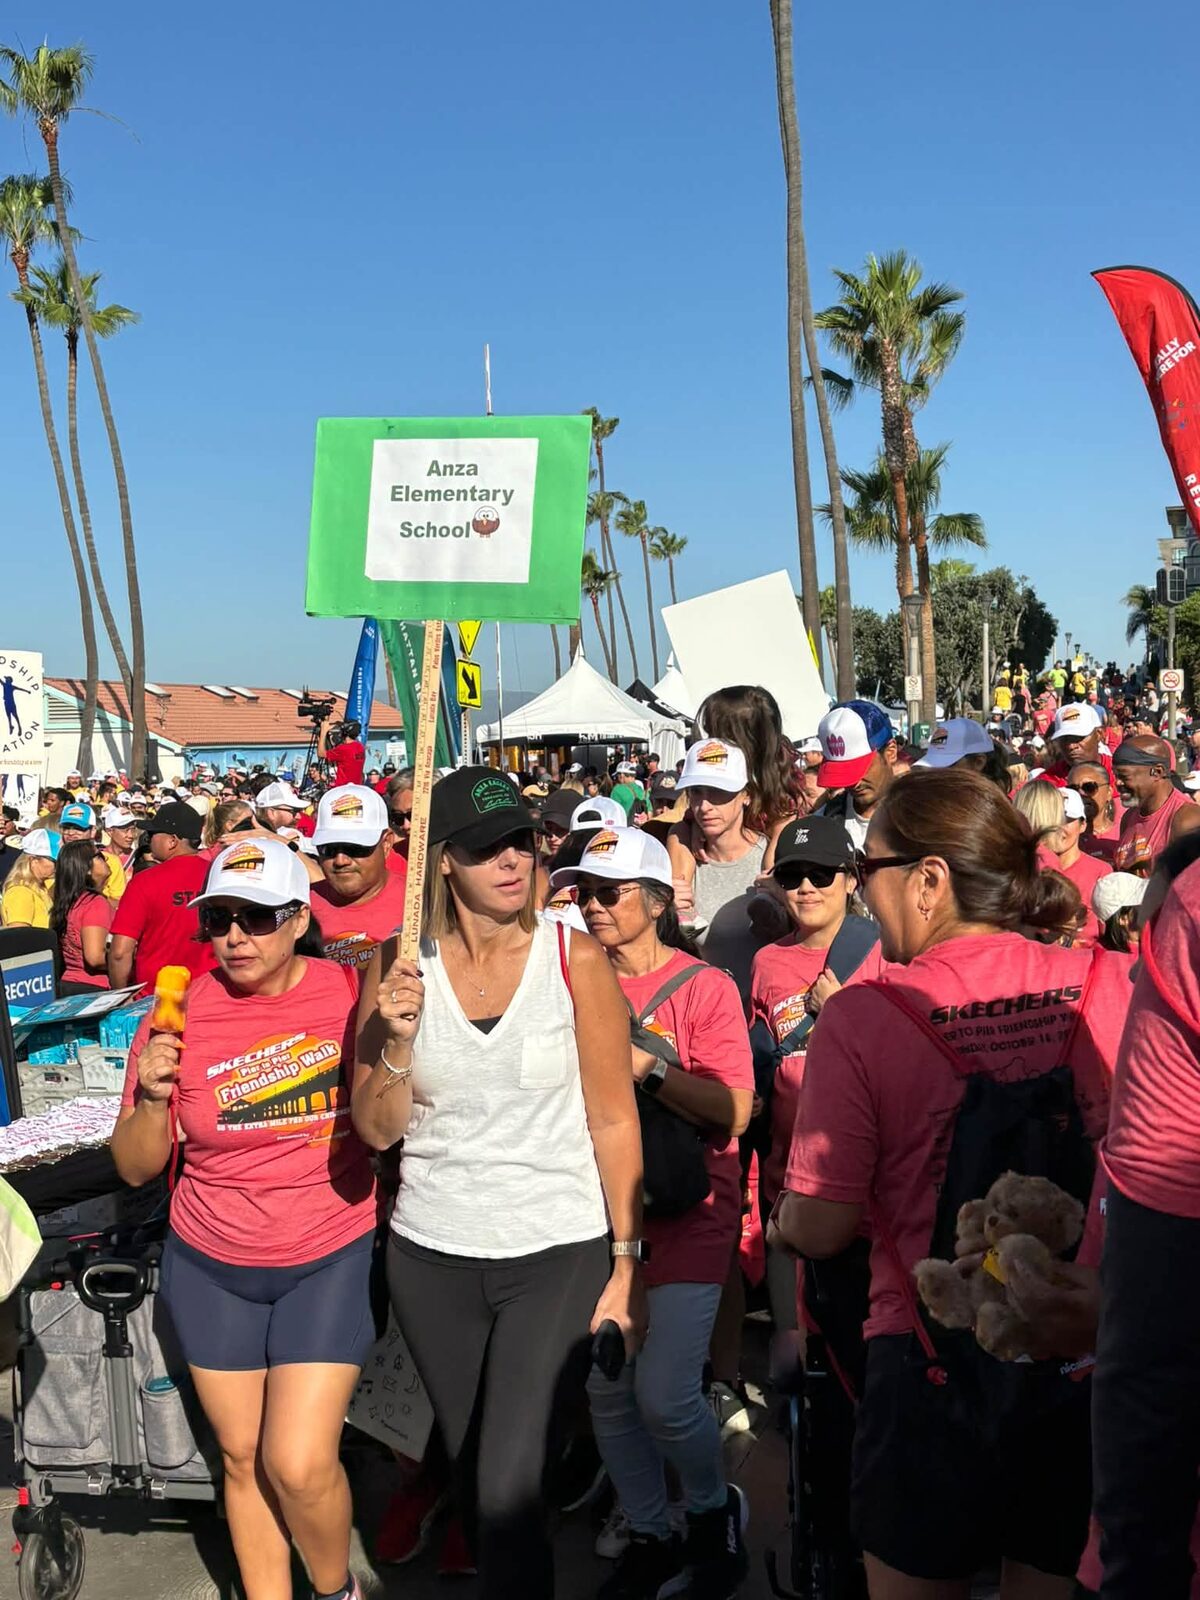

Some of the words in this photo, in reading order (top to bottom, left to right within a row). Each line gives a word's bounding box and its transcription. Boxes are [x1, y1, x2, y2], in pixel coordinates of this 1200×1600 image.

[1171, 341, 1197, 363] FOR
[426, 459, 479, 476] Anza
[390, 485, 515, 506] Elementary
[400, 520, 470, 538] School
[416, 817, 428, 887] HARDWARE
[172, 891, 201, 906] ST
[410, 894, 423, 943] LUNADA
[4, 974, 52, 1000] RECYCLE
[930, 984, 1083, 1026] SKECHERS
[997, 1016, 1057, 1036] FRIENDSHIP
[206, 1032, 307, 1080] SKECHERS
[240, 1065, 260, 1077] Pier
[262, 1061, 271, 1070] to
[271, 1052, 292, 1066] Pier
[220, 1062, 300, 1104] Friendship
[300, 1042, 338, 1068] Walk
[228, 1122, 242, 1132] THE
[244, 1118, 268, 1130] EXTRA
[269, 1117, 288, 1128] MILE
